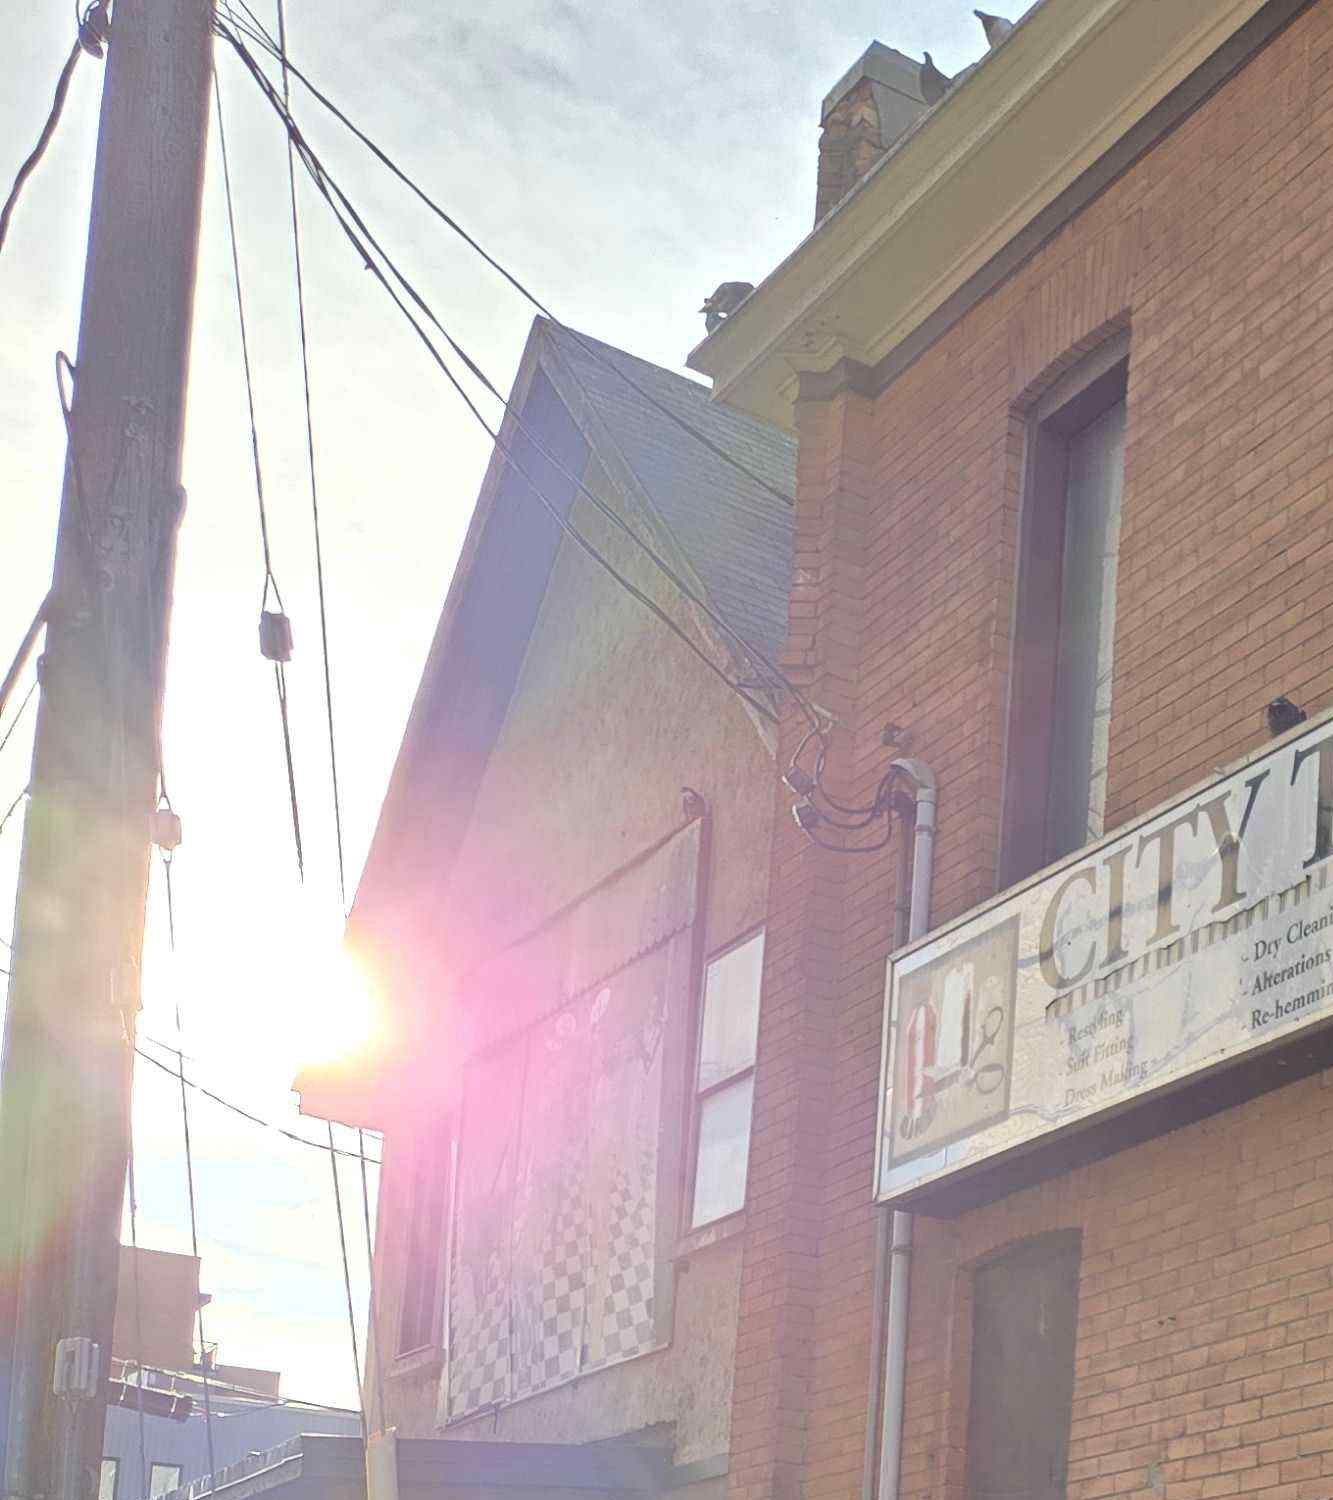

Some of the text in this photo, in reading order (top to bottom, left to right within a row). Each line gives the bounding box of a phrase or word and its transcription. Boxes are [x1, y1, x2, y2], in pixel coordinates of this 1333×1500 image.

[1039, 768, 1270, 991] CITY
[1251, 948, 1332, 997] Alterations
[1253, 938, 1282, 962] Dry
